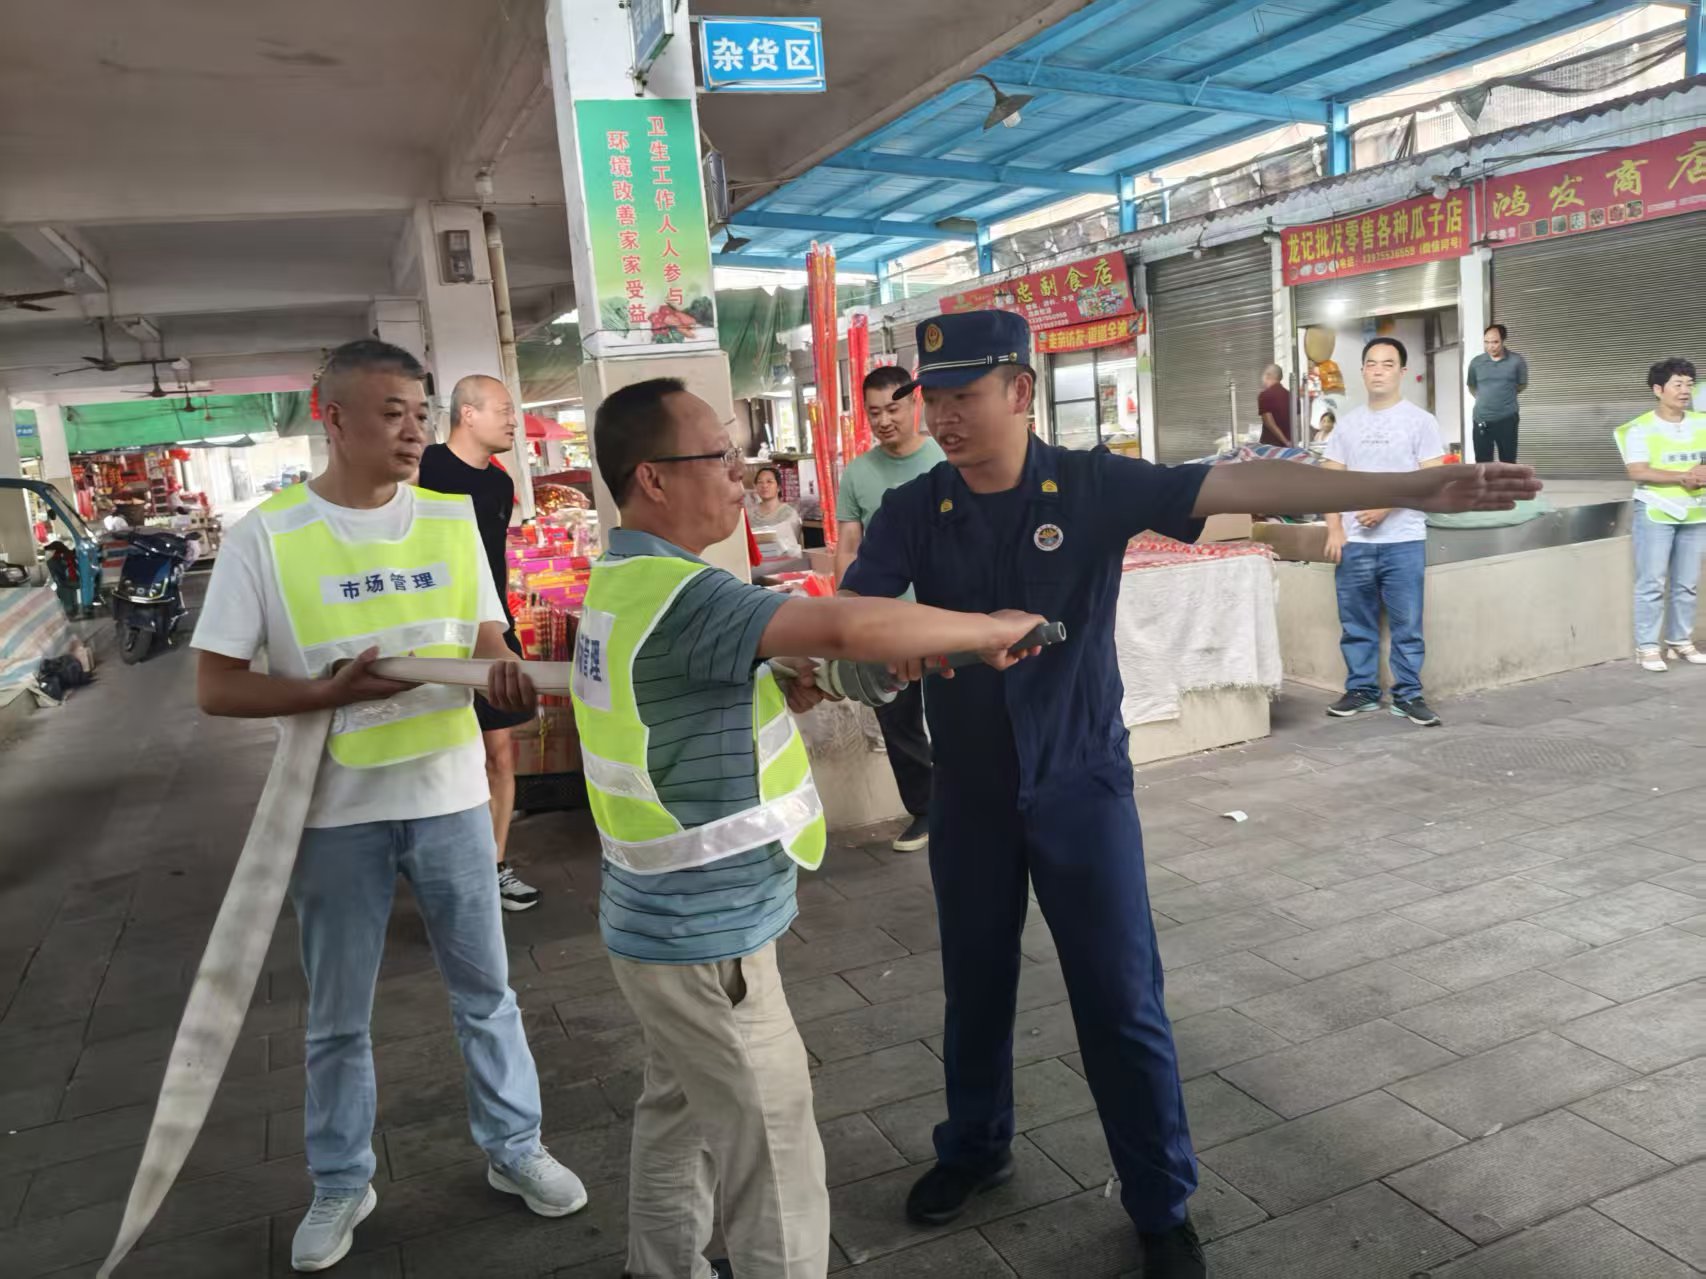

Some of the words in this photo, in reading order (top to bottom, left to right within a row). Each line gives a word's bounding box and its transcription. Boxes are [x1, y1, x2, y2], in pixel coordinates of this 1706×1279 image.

[712, 38, 814, 70] 杂货区
[606, 131, 649, 324] 环境改善家家受益
[648, 116, 684, 305] 卫生工作人人参与
[993, 257, 1113, 304] 忠副食店
[339, 571, 436, 600] 市场管理
